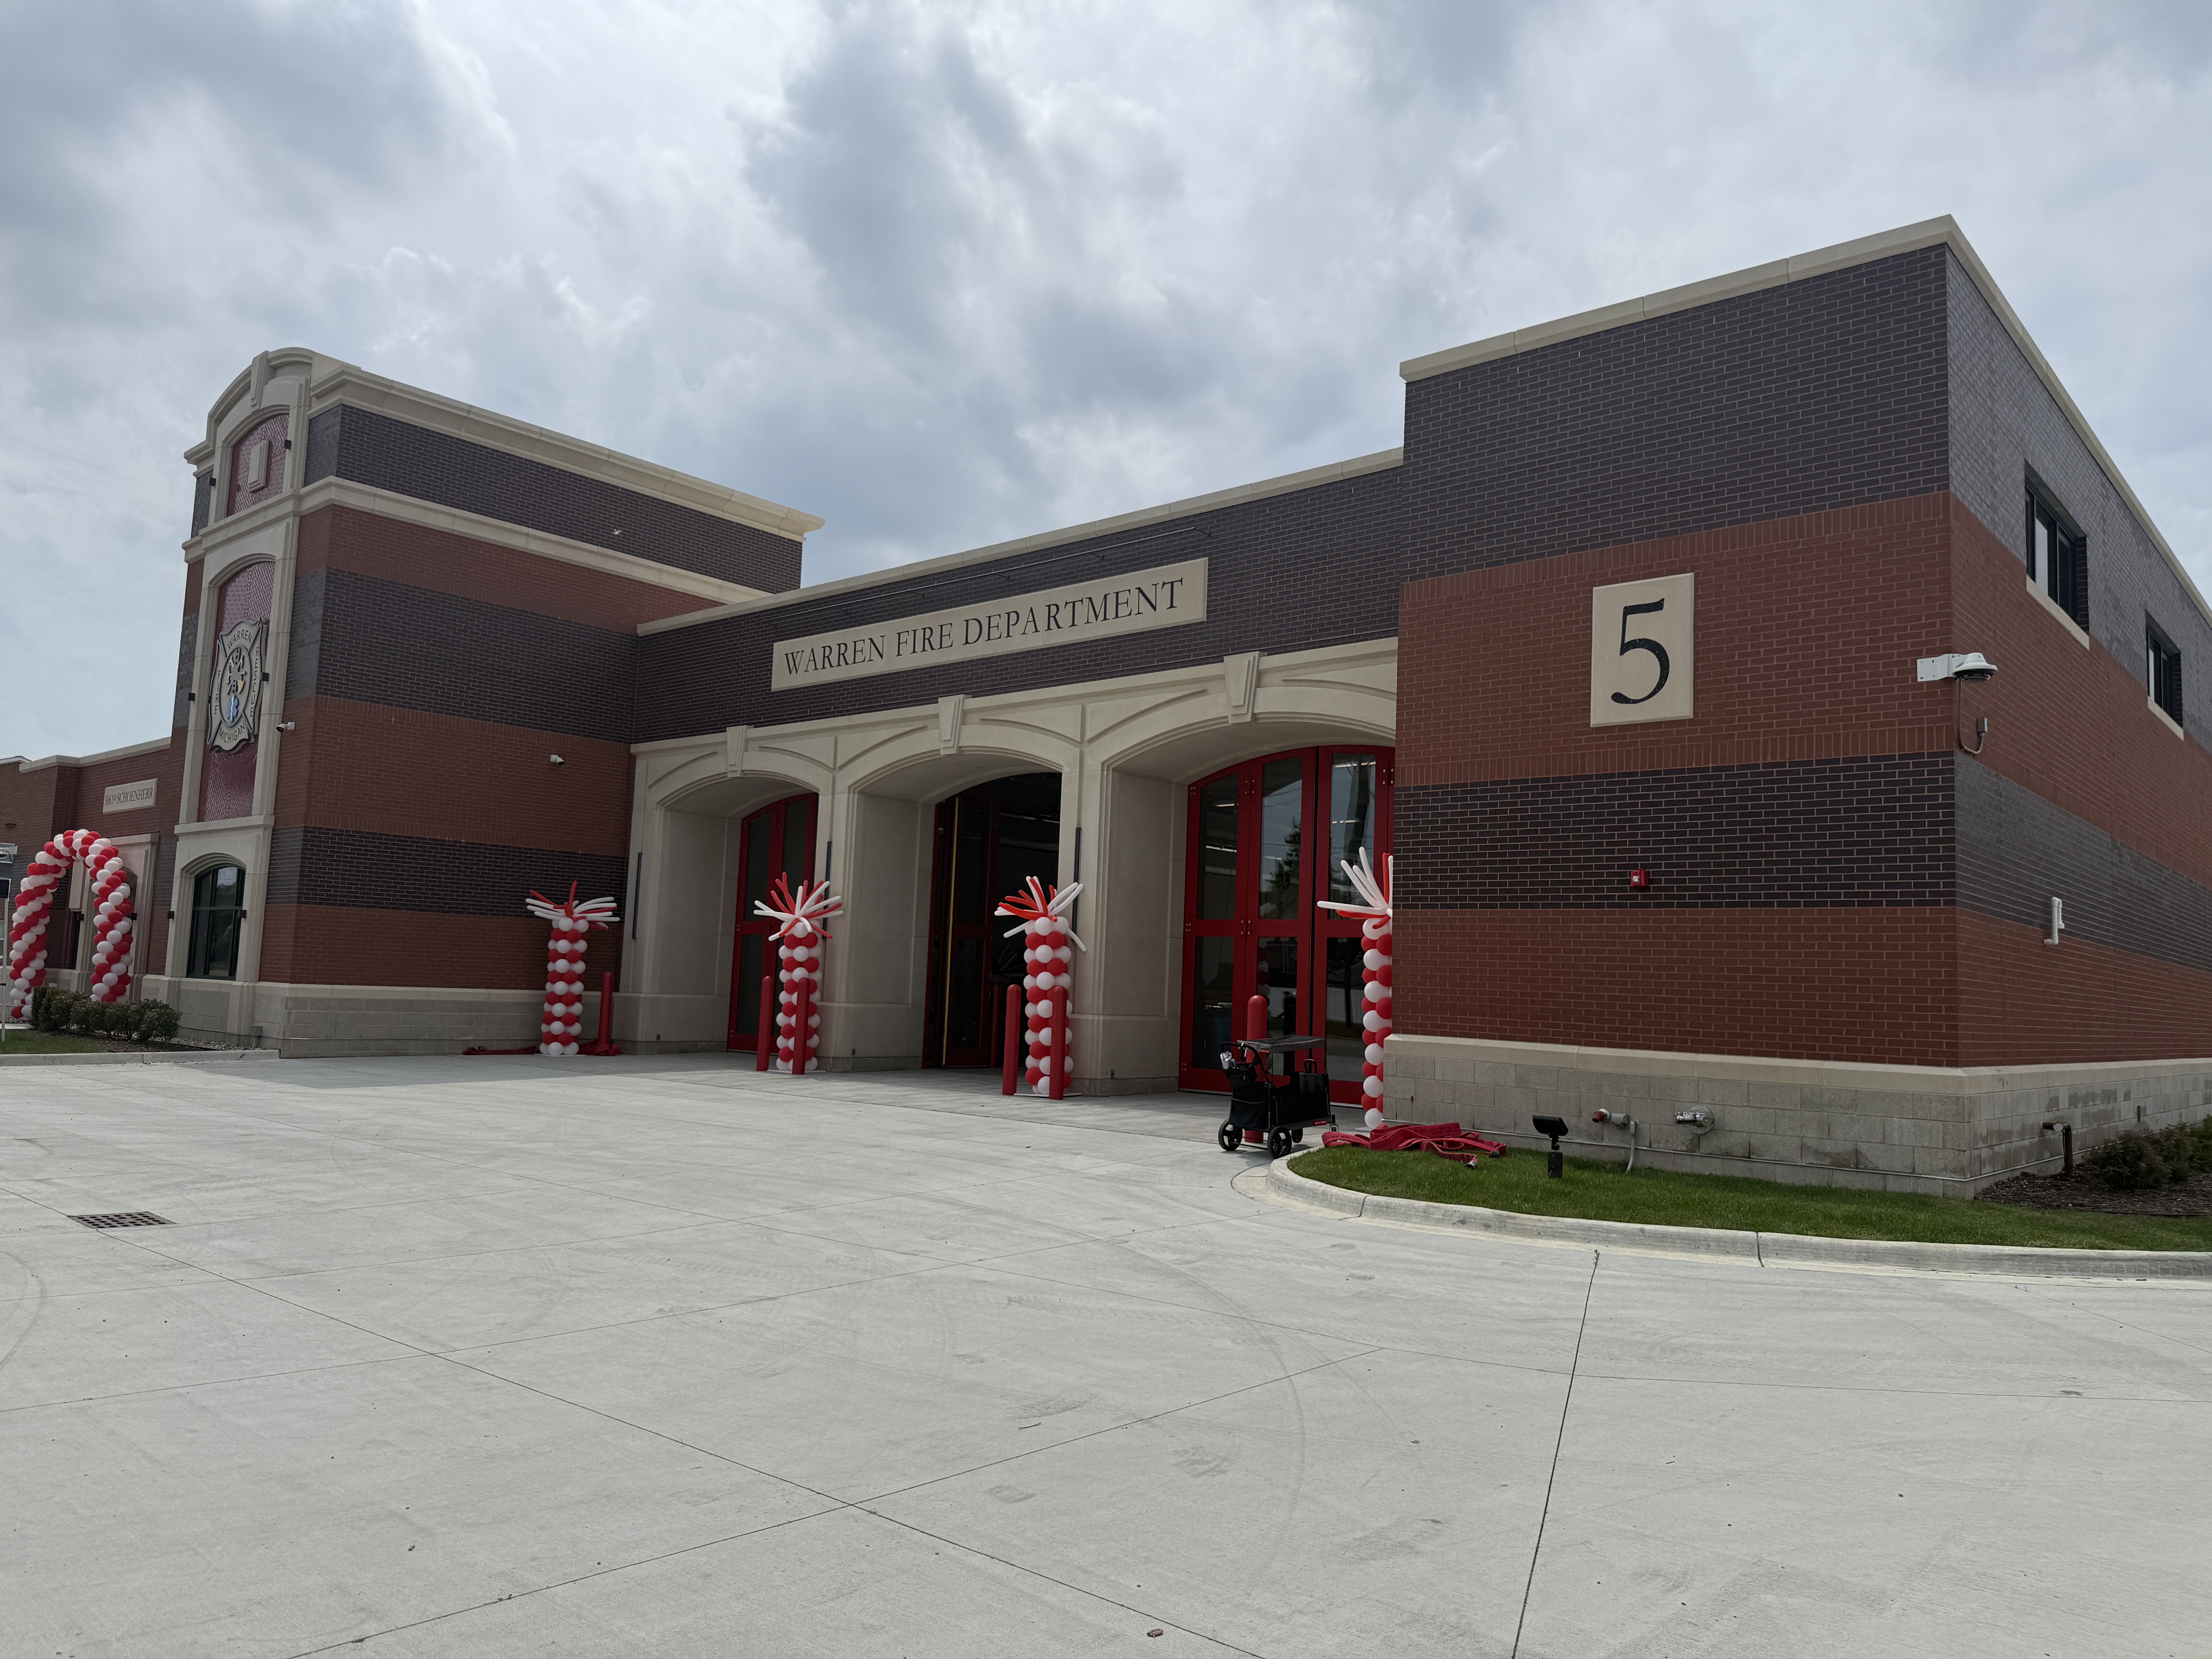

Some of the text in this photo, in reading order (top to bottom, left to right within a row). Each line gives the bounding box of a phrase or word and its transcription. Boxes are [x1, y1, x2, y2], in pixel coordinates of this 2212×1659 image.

[228, 630, 252, 650] WARREN
[785, 577, 1183, 675] WARREN FIRE DEPARTMENT
[1611, 598, 1670, 704] 5
[250, 647, 259, 717] RESCUE
[218, 722, 246, 744] MICHIGAN
[117, 787, 153, 804] SCHOENHERR
